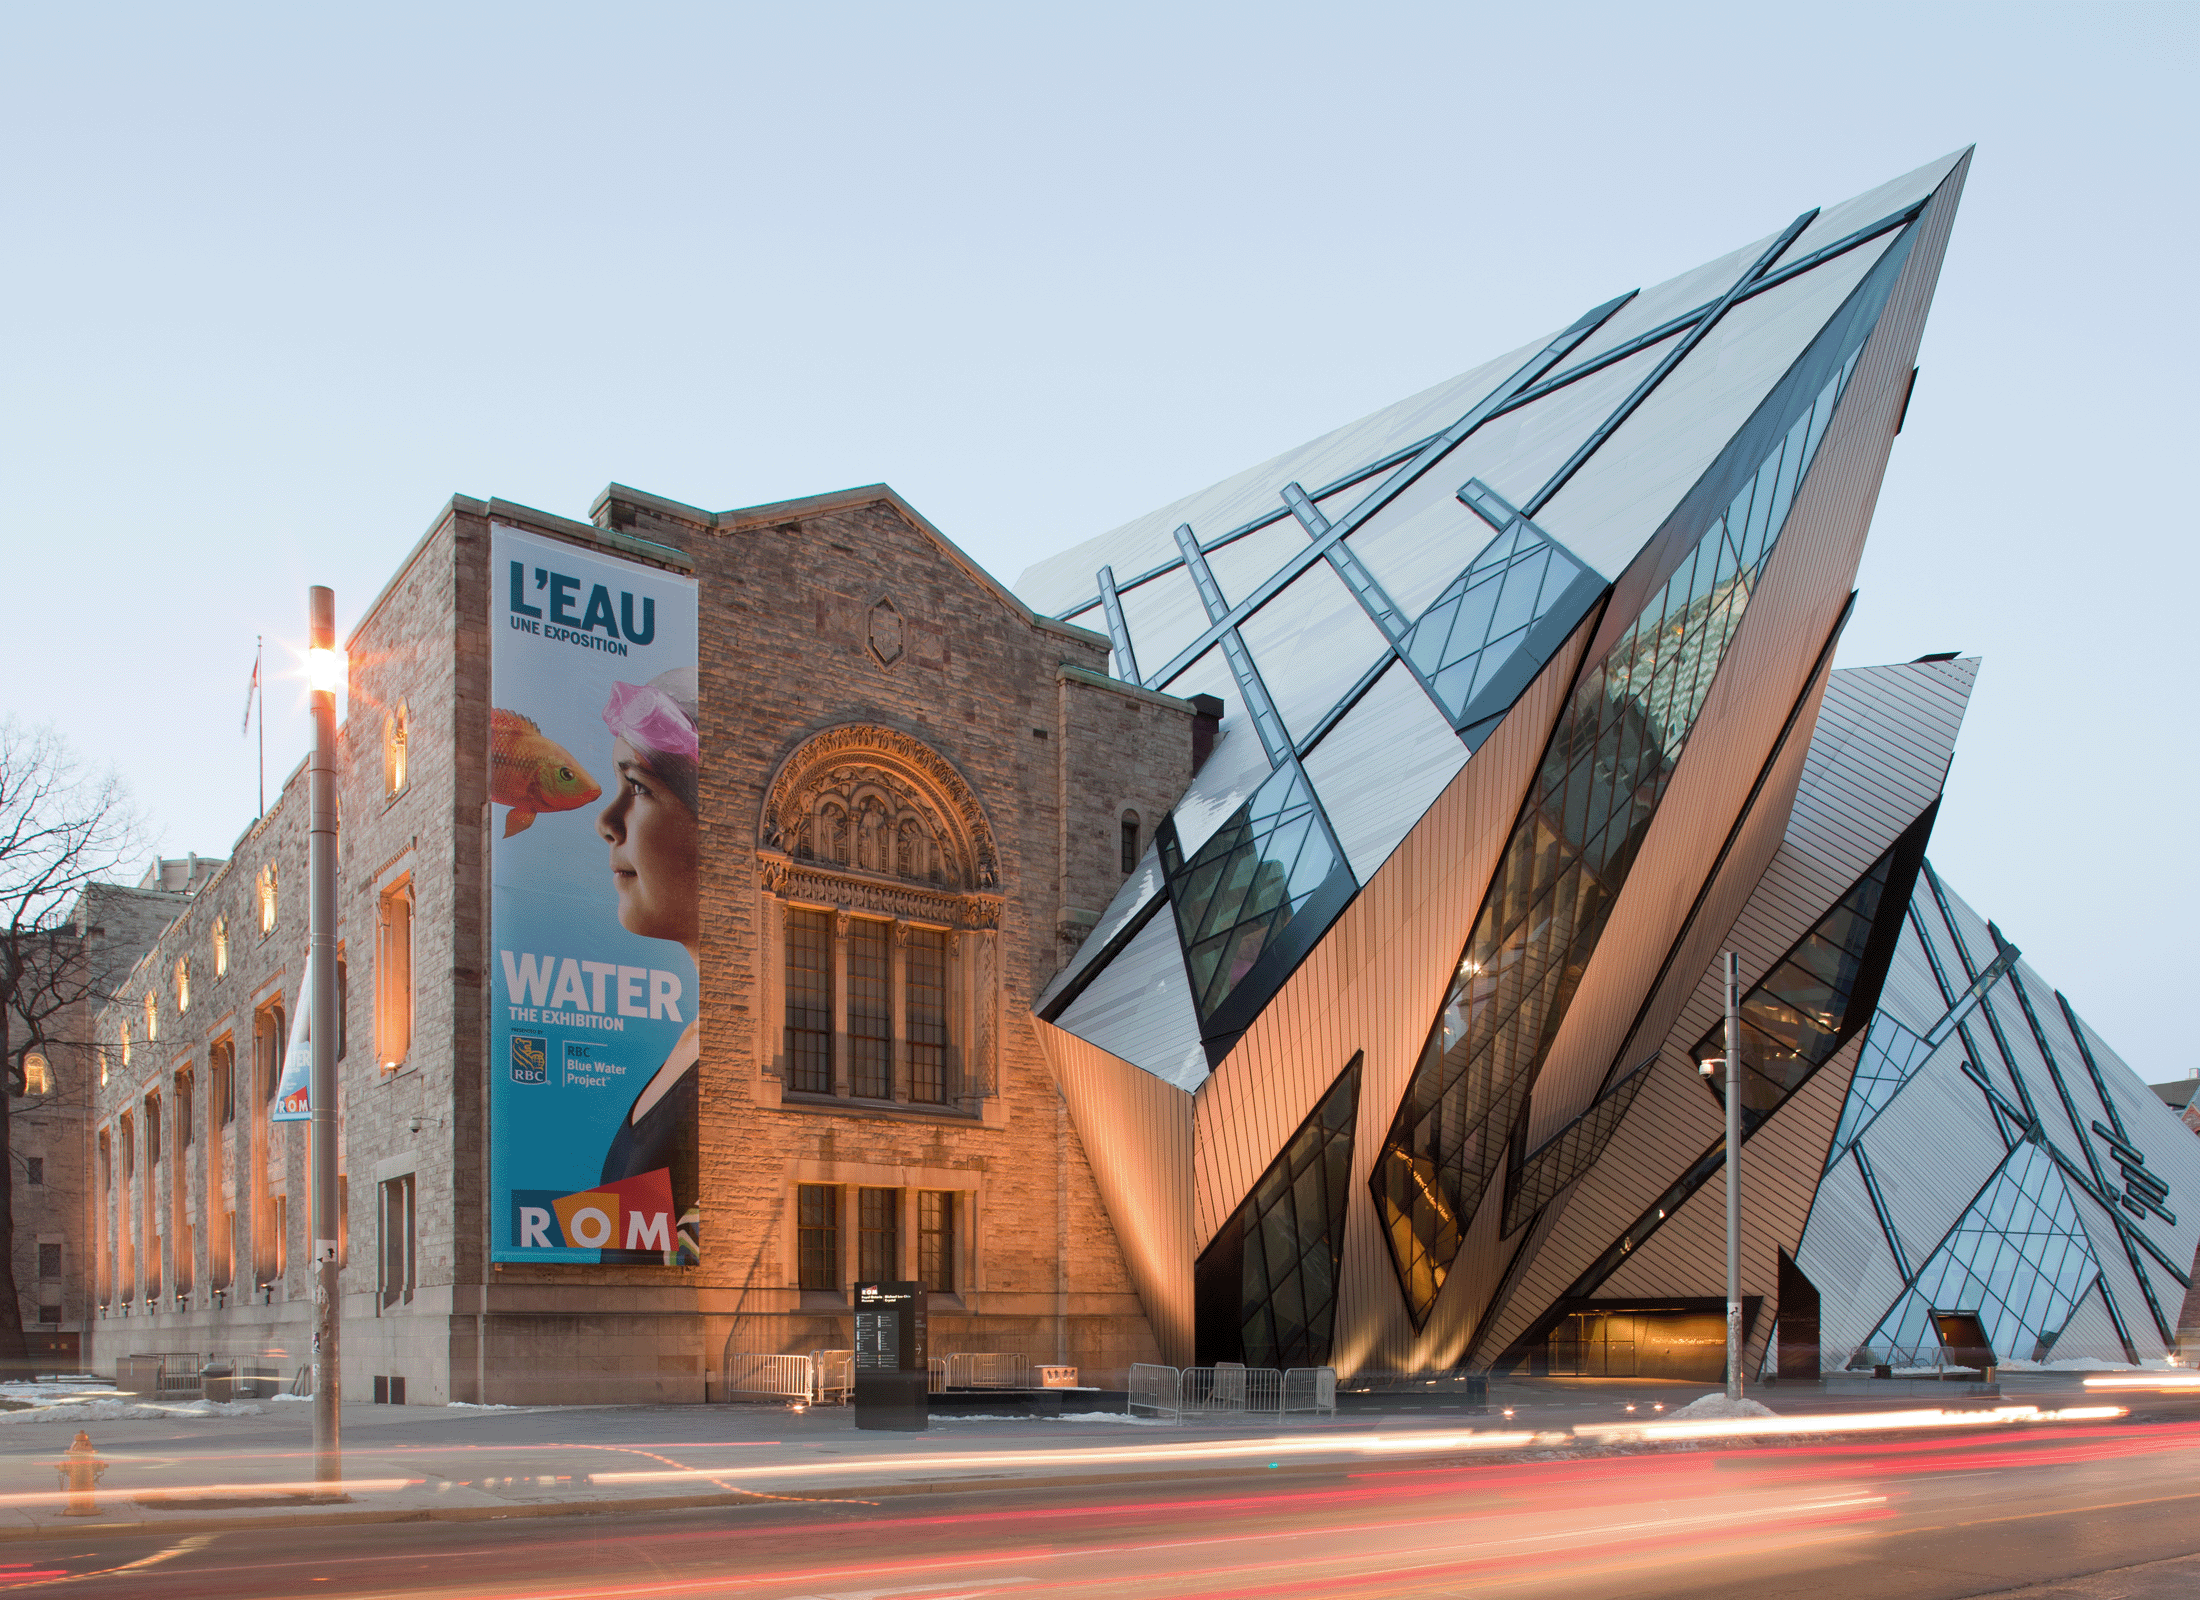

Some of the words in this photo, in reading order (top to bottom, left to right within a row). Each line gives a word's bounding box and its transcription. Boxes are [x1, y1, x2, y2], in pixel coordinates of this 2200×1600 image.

[510, 560, 655, 646] L'EAU
[510, 615, 540, 635] UNE
[544, 624, 628, 657] EXPOSITION
[500, 949, 683, 1023] WATER
[508, 1006, 538, 1023] THE
[542, 1009, 624, 1032] EXHIBITION
[567, 1045, 591, 1058] RBC
[514, 1069, 544, 1082] RBC
[567, 1059, 592, 1072] Blue
[594, 1061, 627, 1075] Water
[279, 1099, 309, 1114] ROM
[519, 1206, 672, 1251] ROM
